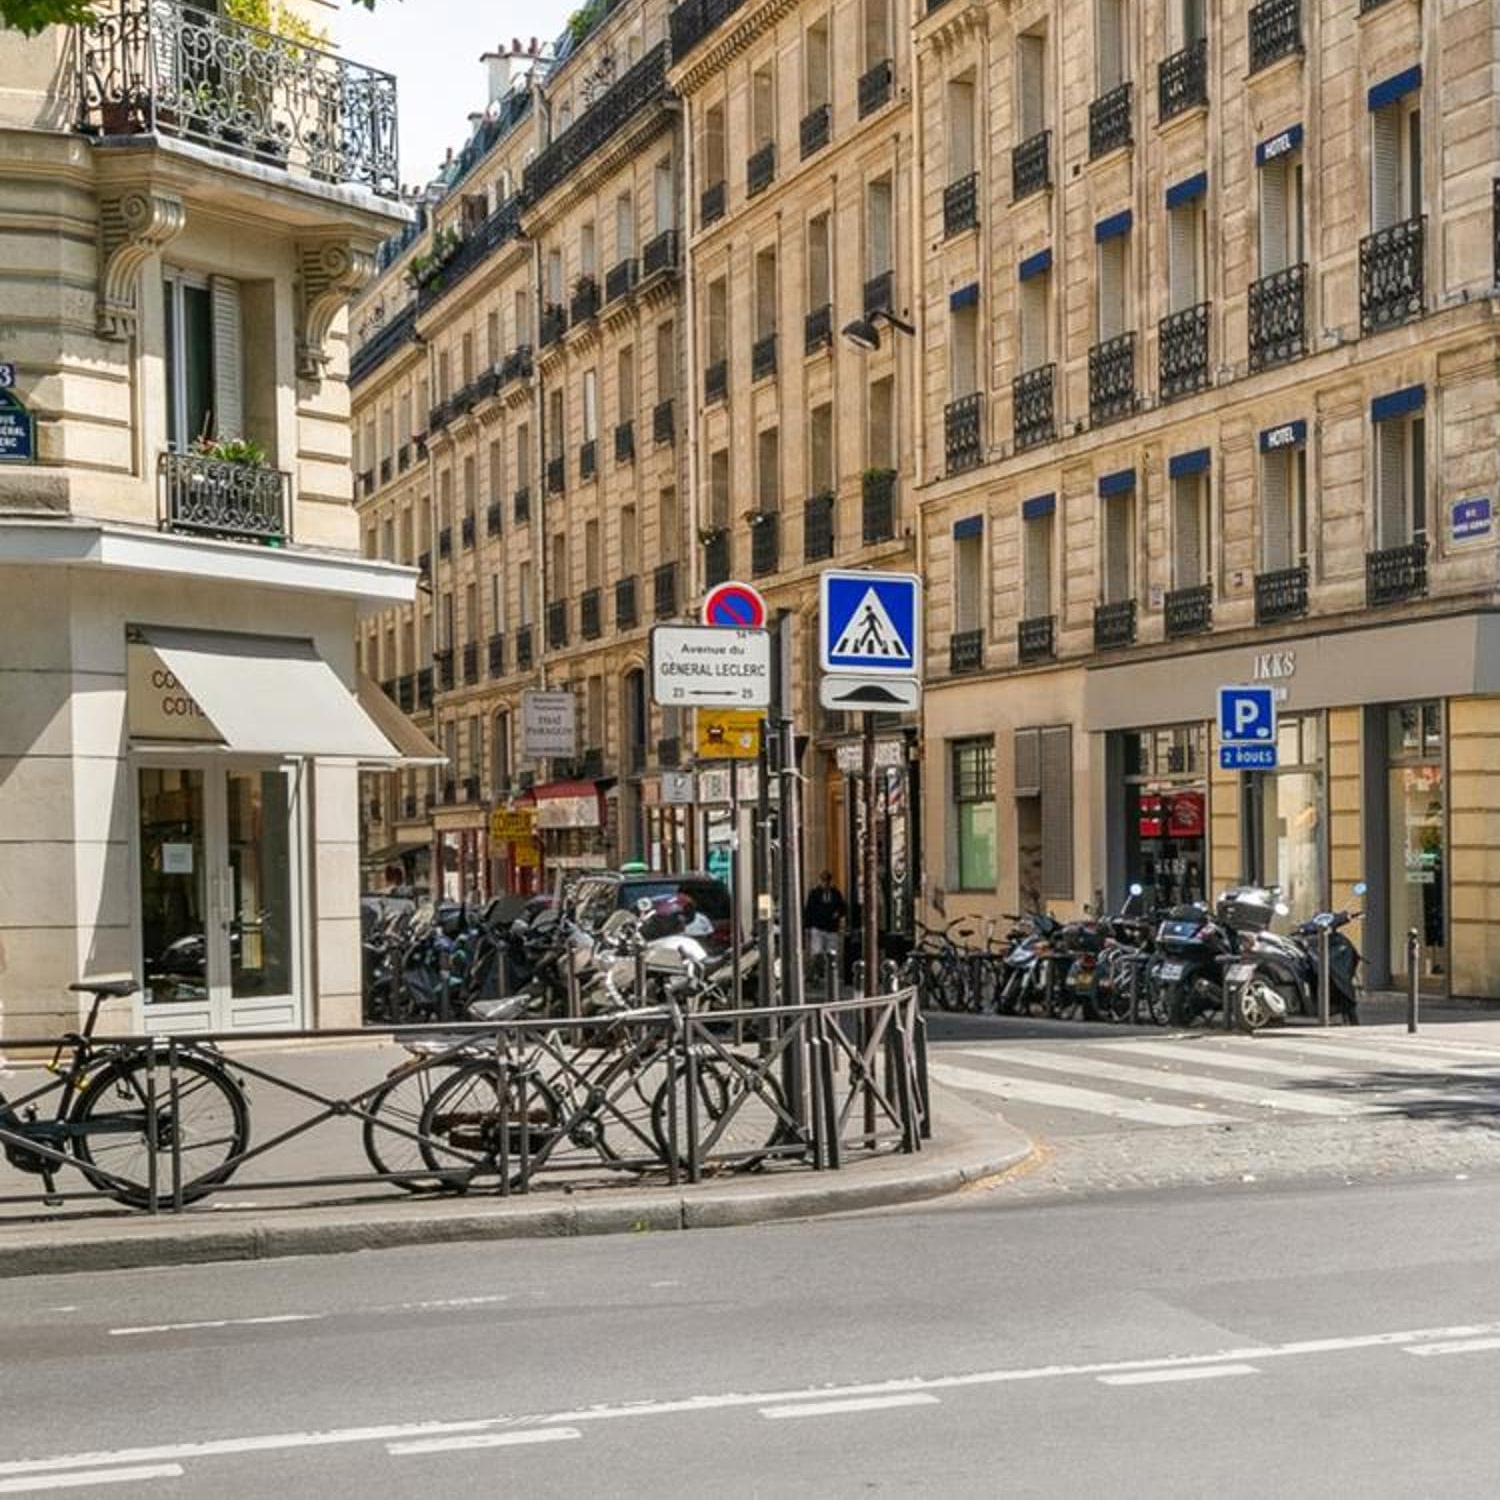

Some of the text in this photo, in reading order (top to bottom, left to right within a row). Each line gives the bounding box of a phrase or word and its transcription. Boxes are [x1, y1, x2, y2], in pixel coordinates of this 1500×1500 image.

[681, 643, 745, 655] Avenue du
[715, 663, 766, 677] LECLERC
[1253, 650, 1295, 680] IKKS
[1235, 699, 1259, 733] P
[1223, 749, 1274, 764] 2 ROUES
